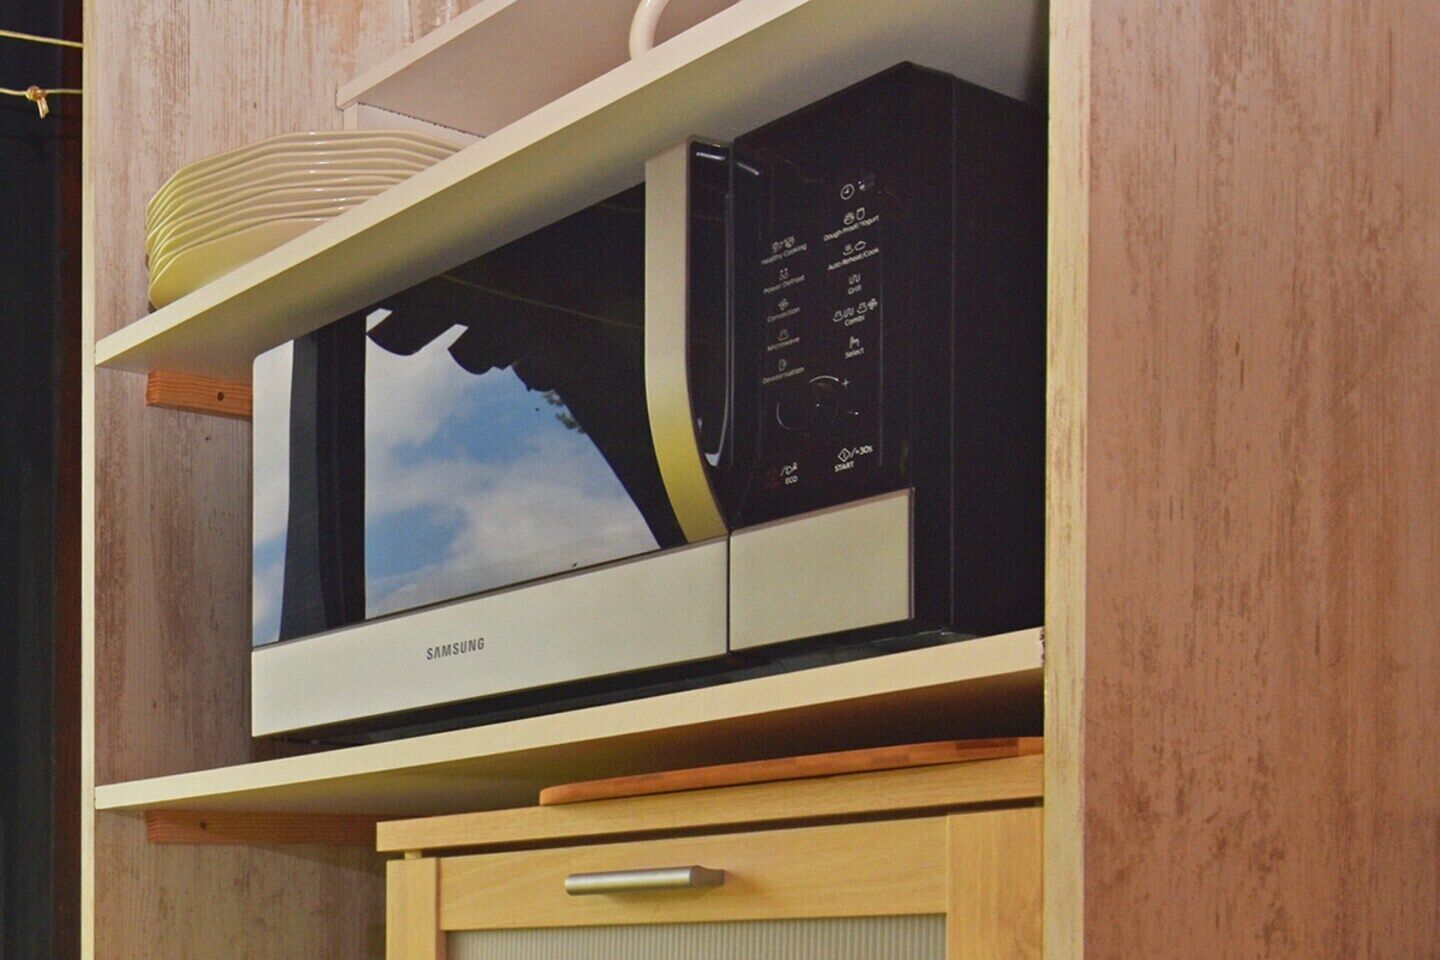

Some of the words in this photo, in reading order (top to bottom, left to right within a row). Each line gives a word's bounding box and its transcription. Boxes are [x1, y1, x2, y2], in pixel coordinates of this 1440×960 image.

[767, 307, 800, 323] Convection
[844, 314, 865, 326] Combi
[845, 347, 865, 359] Select
[834, 460, 855, 473] START
[785, 475, 799, 485] ECO
[426, 637, 485, 660] SAMSUNG
